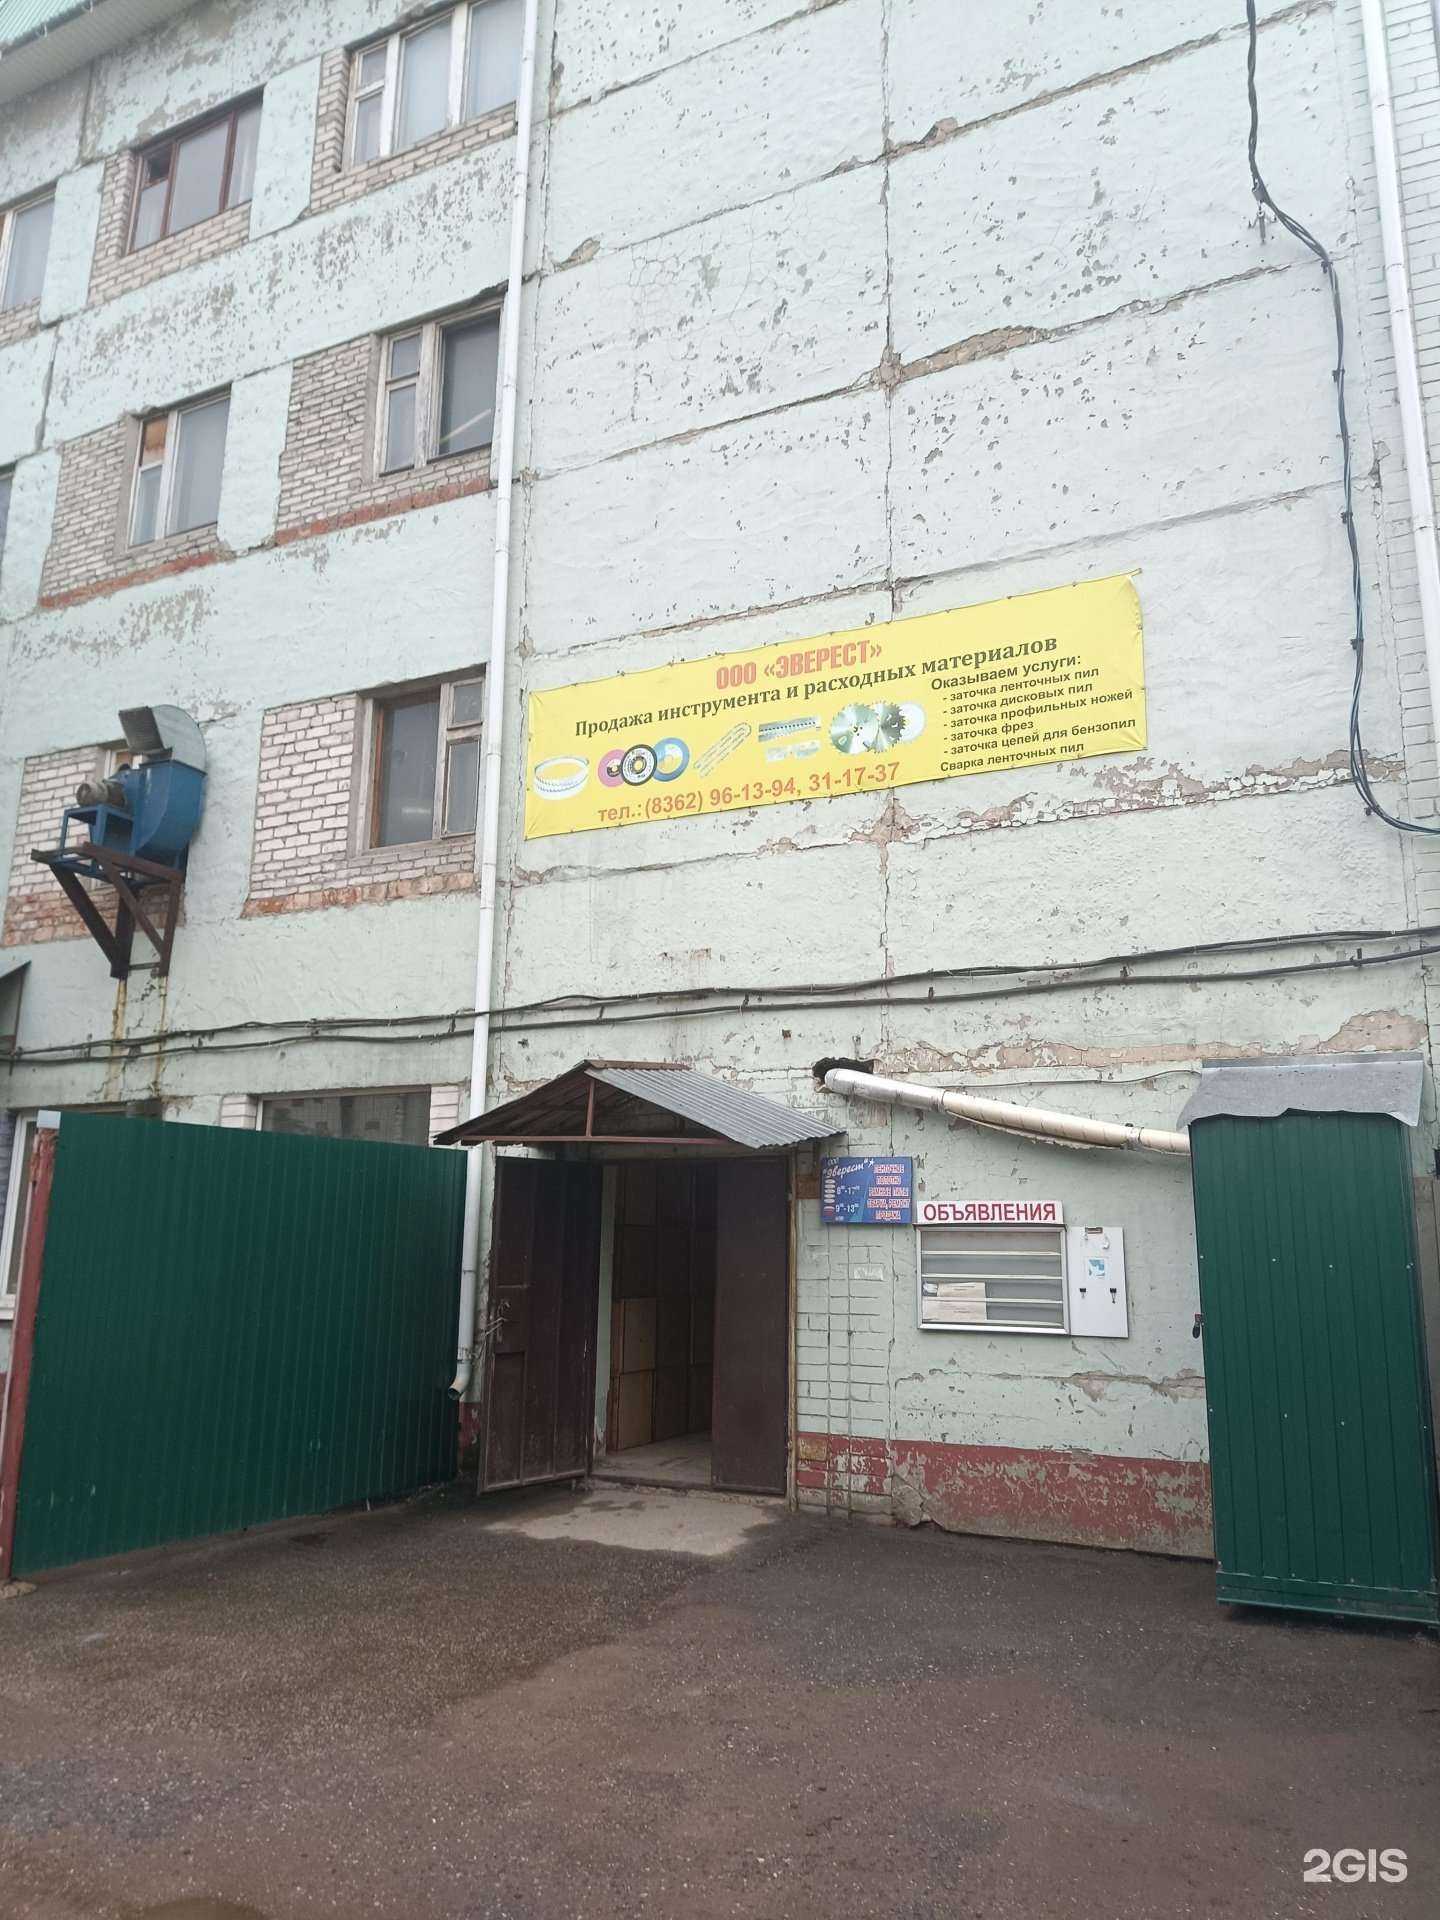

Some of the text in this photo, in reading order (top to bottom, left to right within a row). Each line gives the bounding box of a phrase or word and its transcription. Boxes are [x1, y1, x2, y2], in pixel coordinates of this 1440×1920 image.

[716, 639, 882, 690] ООО «ЭВЕРЕСТ»
[931, 655, 1082, 691] Оказываем услуги:
[574, 637, 1058, 737] Продажа инструмента и расходных материалов
[950, 686, 997, 701] заточка
[1000, 675, 1071, 694] ленточных
[1074, 667, 1099, 679] пил
[950, 699, 997, 715] заточка
[1000, 688, 1065, 708] дисковых
[1068, 682, 1093, 693] пил
[950, 713, 997, 728] заточка
[1000, 699, 1087, 722] профильных
[1091, 689, 1133, 705] ножей
[950, 727, 998, 742] заточка
[1001, 720, 1034, 738] фрез
[950, 741, 998, 756] заточка
[1001, 732, 1040, 750] цепей
[1043, 728, 1069, 743] для
[1071, 718, 1136, 736] бензопил
[940, 742, 1084, 772] Сварка ленточных пил
[710, 777, 801, 806] 96-13-94,
[809, 762, 900, 792] 31-17-37
[923, 1203, 1056, 1221] ОБЪЯВЛЕНИЯ
